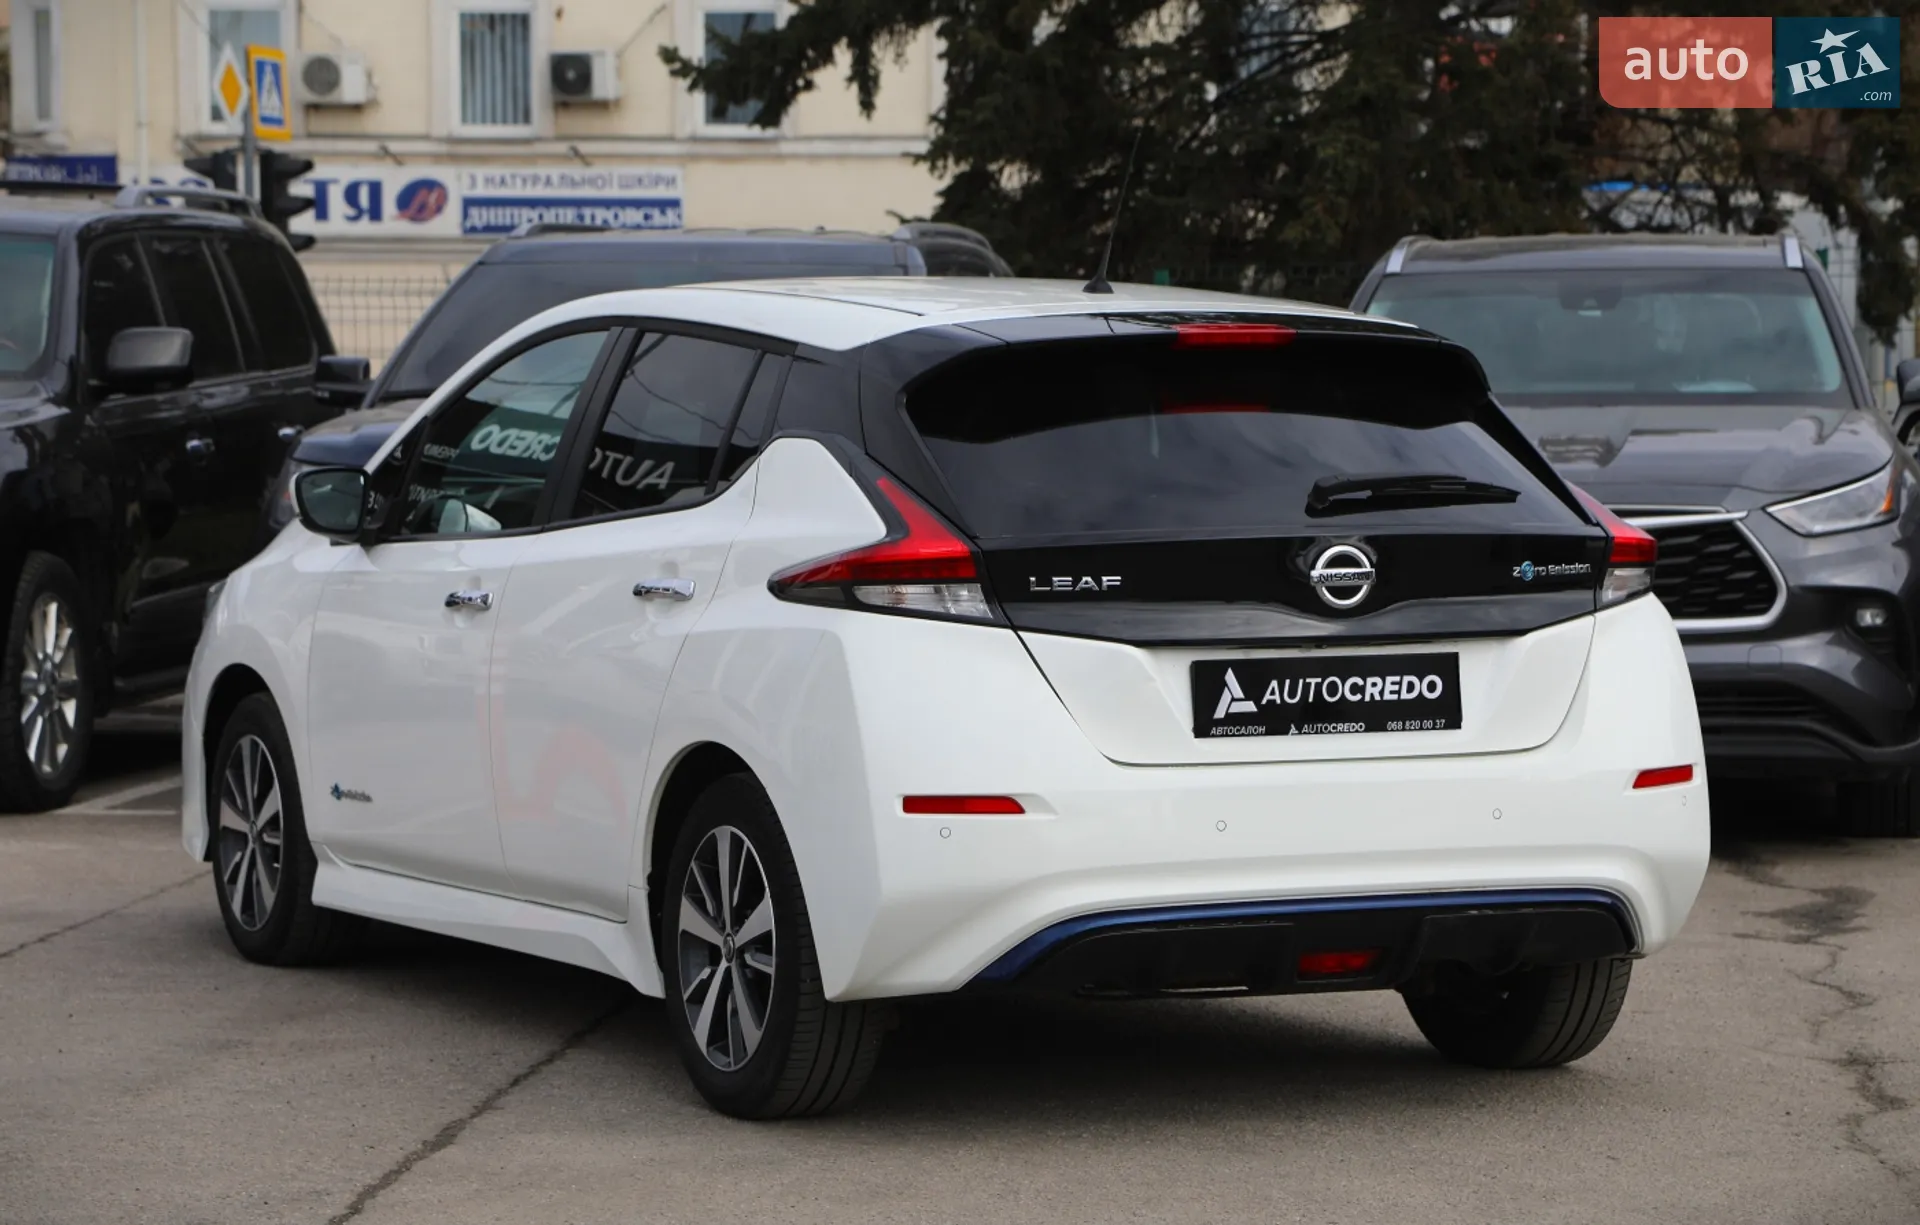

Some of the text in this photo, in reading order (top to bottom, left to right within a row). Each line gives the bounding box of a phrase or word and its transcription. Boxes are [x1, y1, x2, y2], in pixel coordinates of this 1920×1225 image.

[483, 172, 614, 191] НАТУРАЛЬНОЇ
[1548, 562, 1591, 575] Emission
[1029, 575, 1122, 592] LEAF
[1319, 571, 1372, 584] NISSAN
[1261, 674, 1443, 705] AUTOCREDO
[1210, 724, 1266, 736] АВТОСАЛОН
[1301, 722, 1365, 735] AUTOCREDO
[1386, 718, 1446, 731] 068 820 00 37
